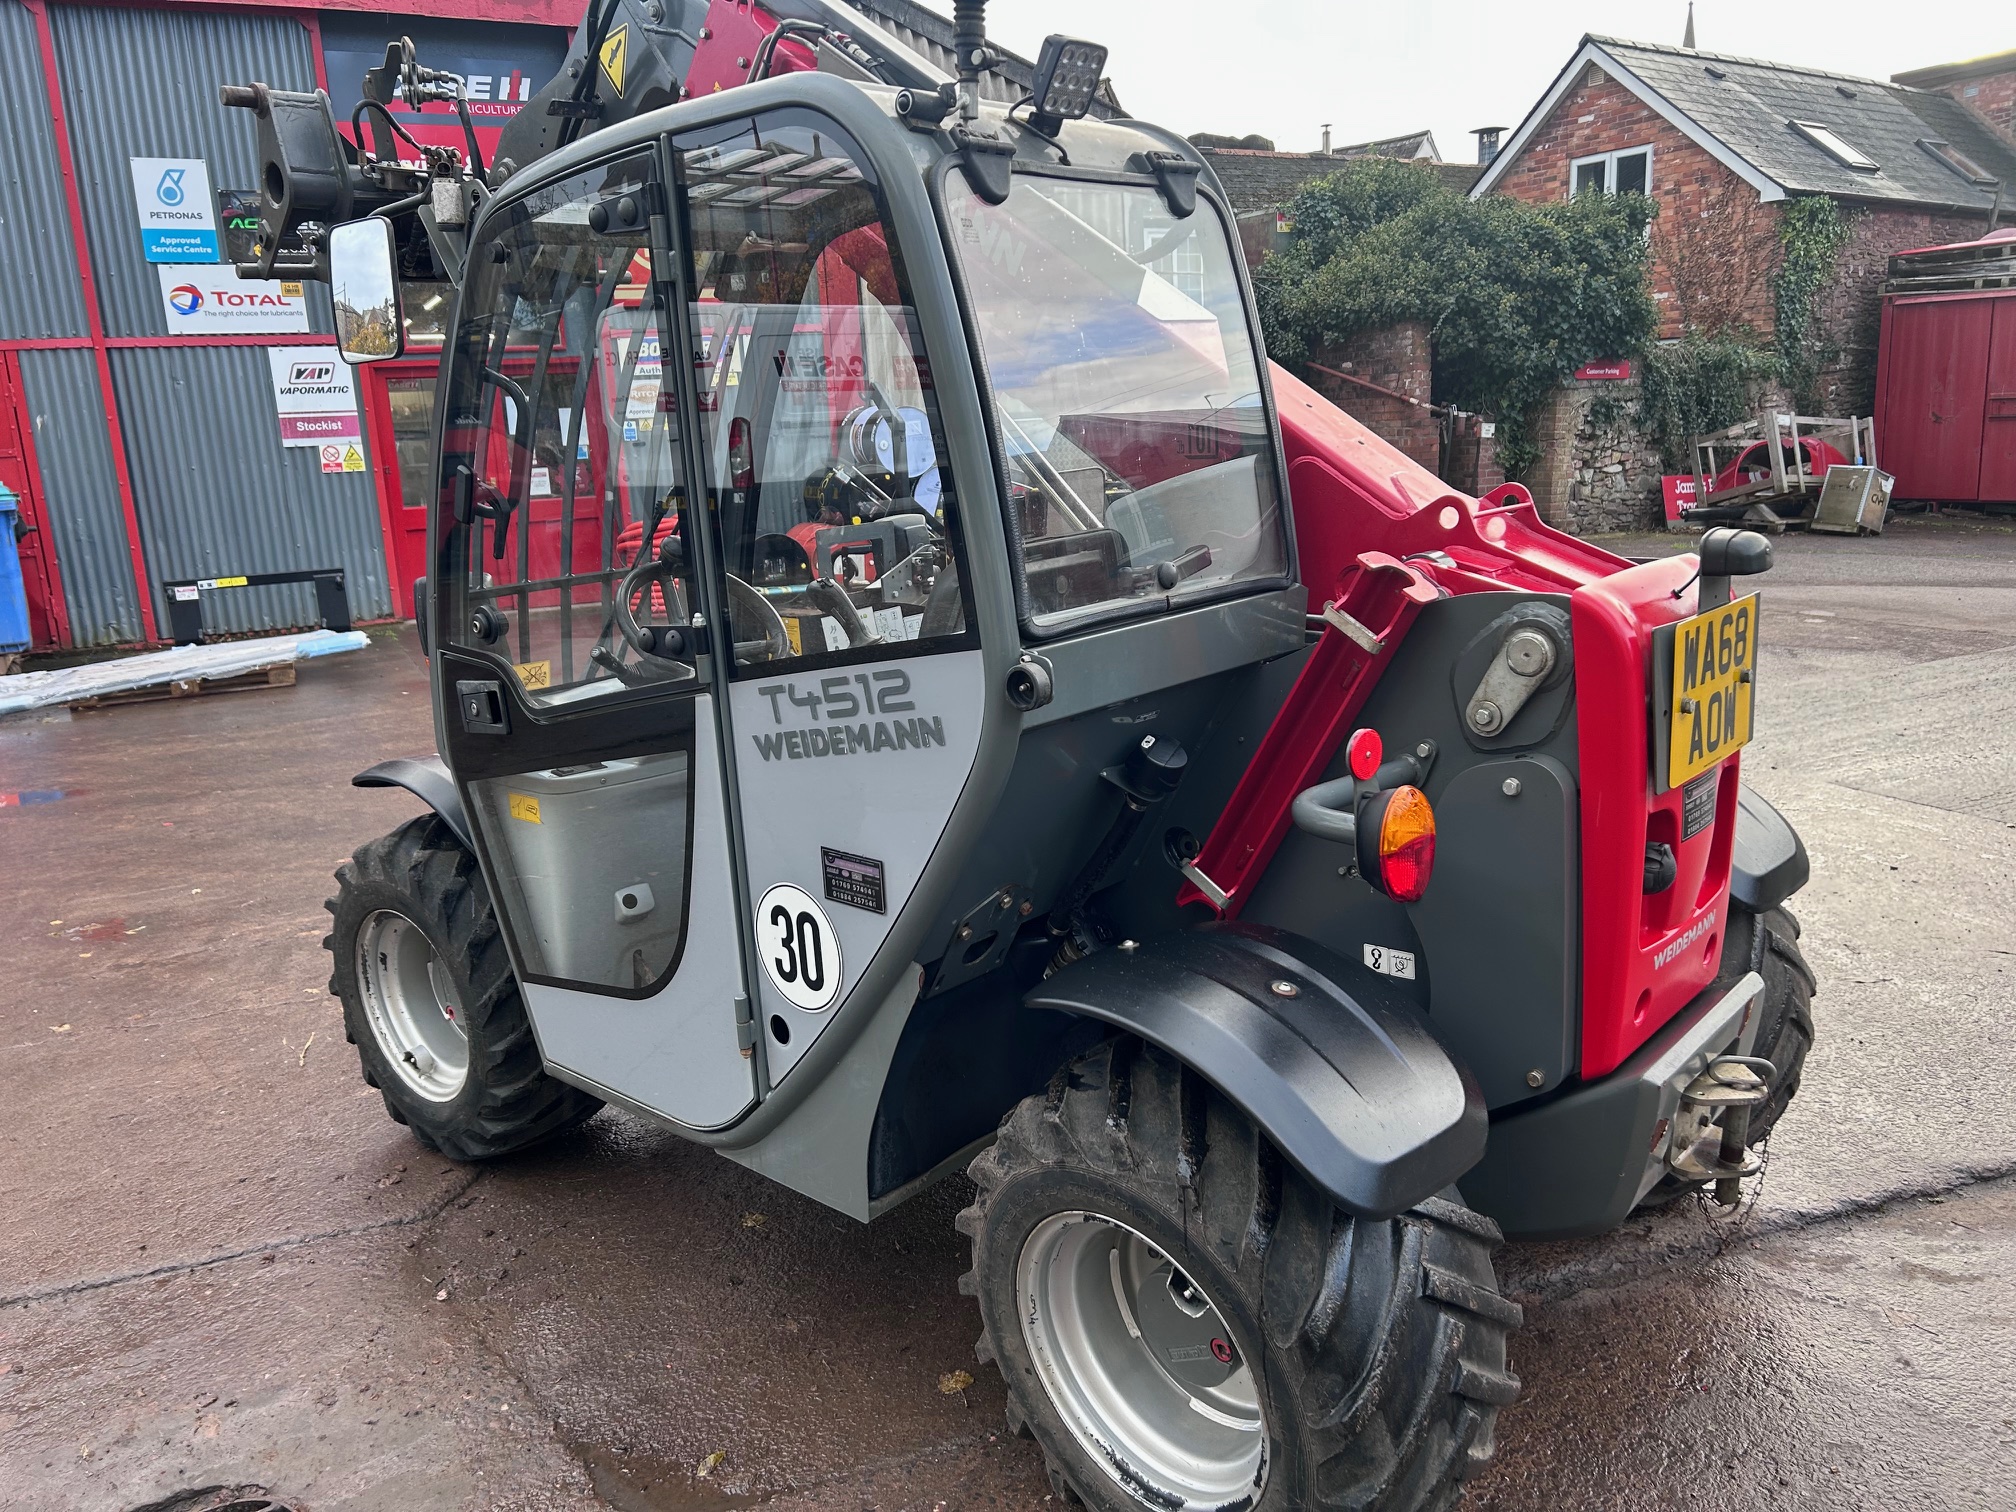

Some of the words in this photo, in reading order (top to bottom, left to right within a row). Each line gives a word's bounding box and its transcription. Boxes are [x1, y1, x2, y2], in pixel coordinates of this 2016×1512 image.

[149, 211, 204, 220] PETRONAS
[159, 236, 201, 245] Approved
[151, 245, 182, 254] Service
[183, 245, 213, 254] Centre
[210, 290, 292, 306] TOTAL
[218, 310, 235, 318] right
[295, 367, 331, 380] VAP
[1586, 367, 1605, 375] Customer
[1605, 367, 1620, 376] Parking
[280, 385, 349, 395] VAPORMATIC
[296, 420, 343, 431] Stockist
[1675, 479, 1707, 494] Jams
[1682, 605, 1749, 692] WA68
[757, 668, 915, 725] T4512
[1687, 683, 1737, 766] AOW
[752, 715, 946, 762] WEIDEMANN
[1653, 908, 1717, 971] WEIDEMANN
[770, 904, 825, 992] 30
